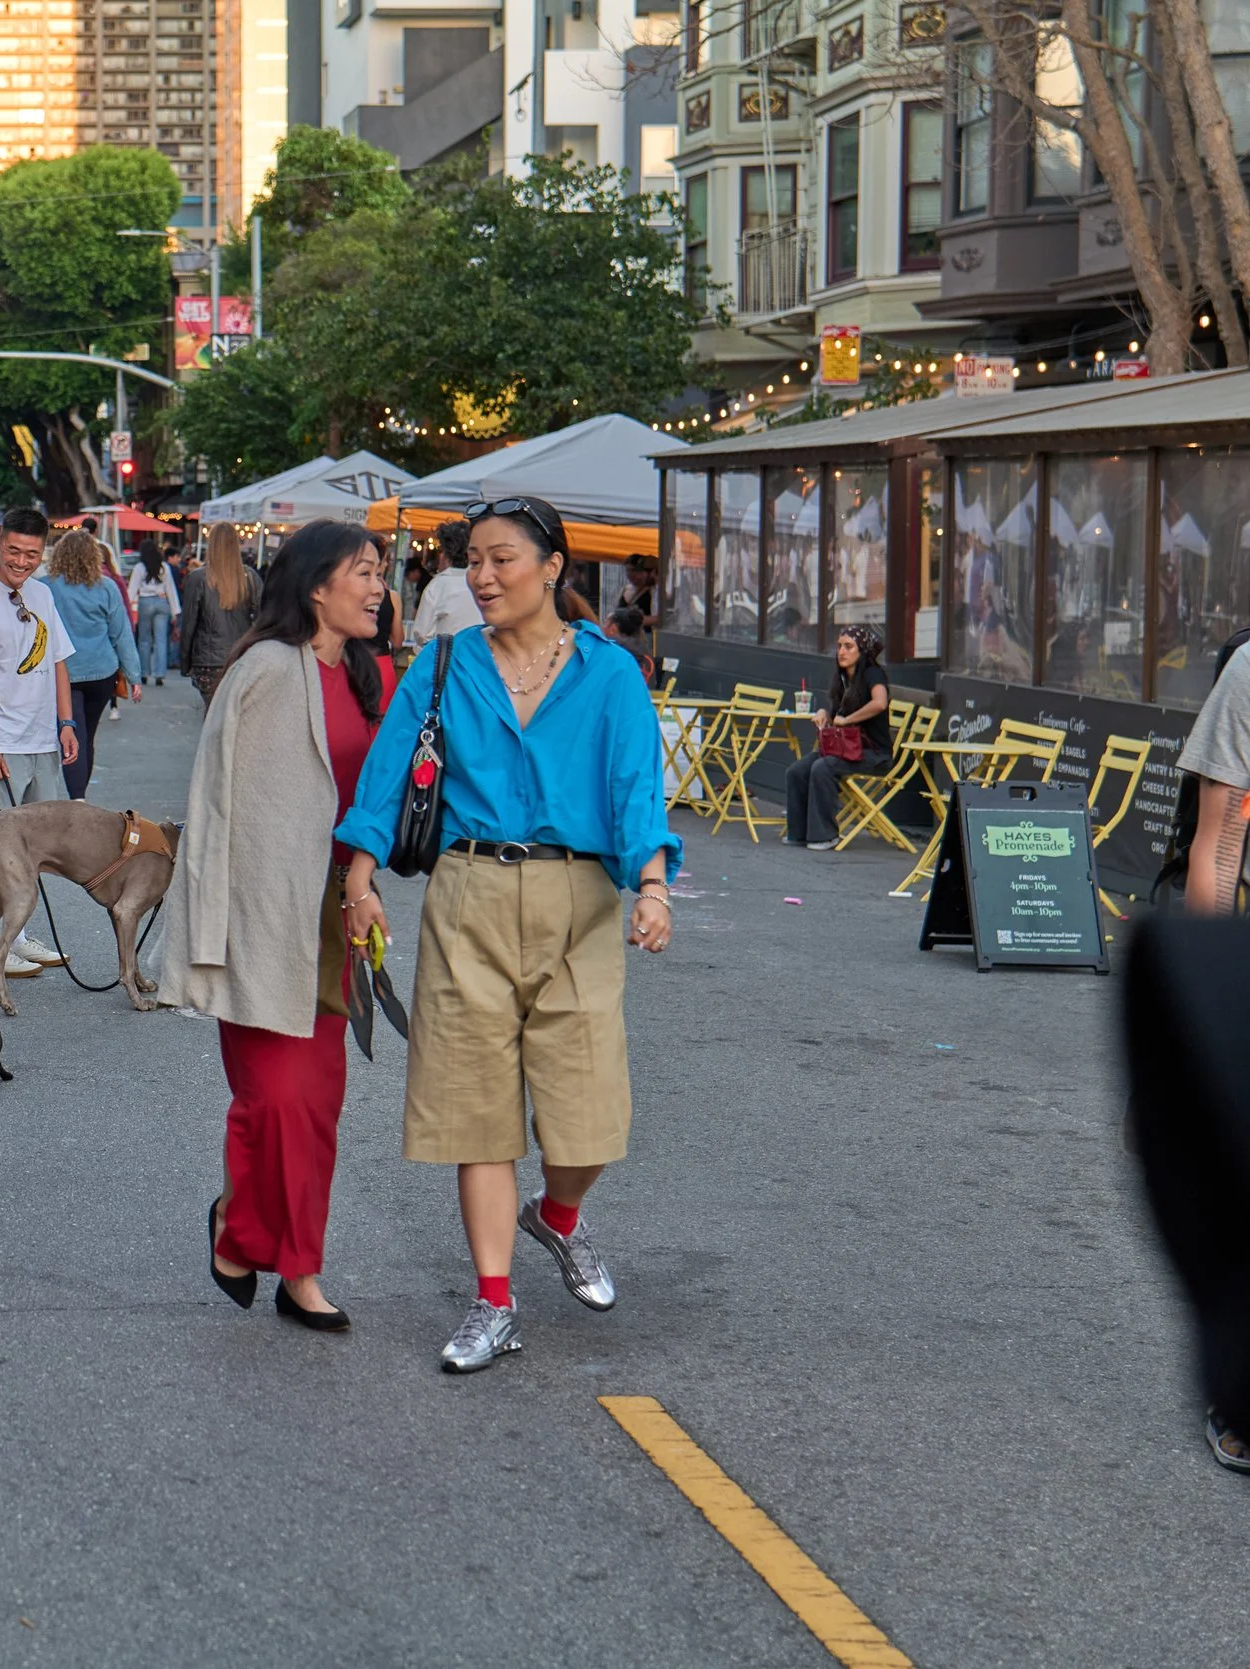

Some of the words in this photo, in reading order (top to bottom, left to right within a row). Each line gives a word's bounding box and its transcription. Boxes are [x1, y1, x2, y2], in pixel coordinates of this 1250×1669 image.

[1065, 745, 1087, 759] BAGELS
[1058, 763, 1090, 779] EMPANADAS
[1145, 763, 1167, 776] PANTRY
[1142, 780, 1165, 796] CHEESE
[1143, 820, 1162, 835] CRAFT
[1004, 831, 1052, 842] HAYES
[995, 838, 1065, 852] Promenade
[1016, 899, 1055, 907] SATURDAYS
